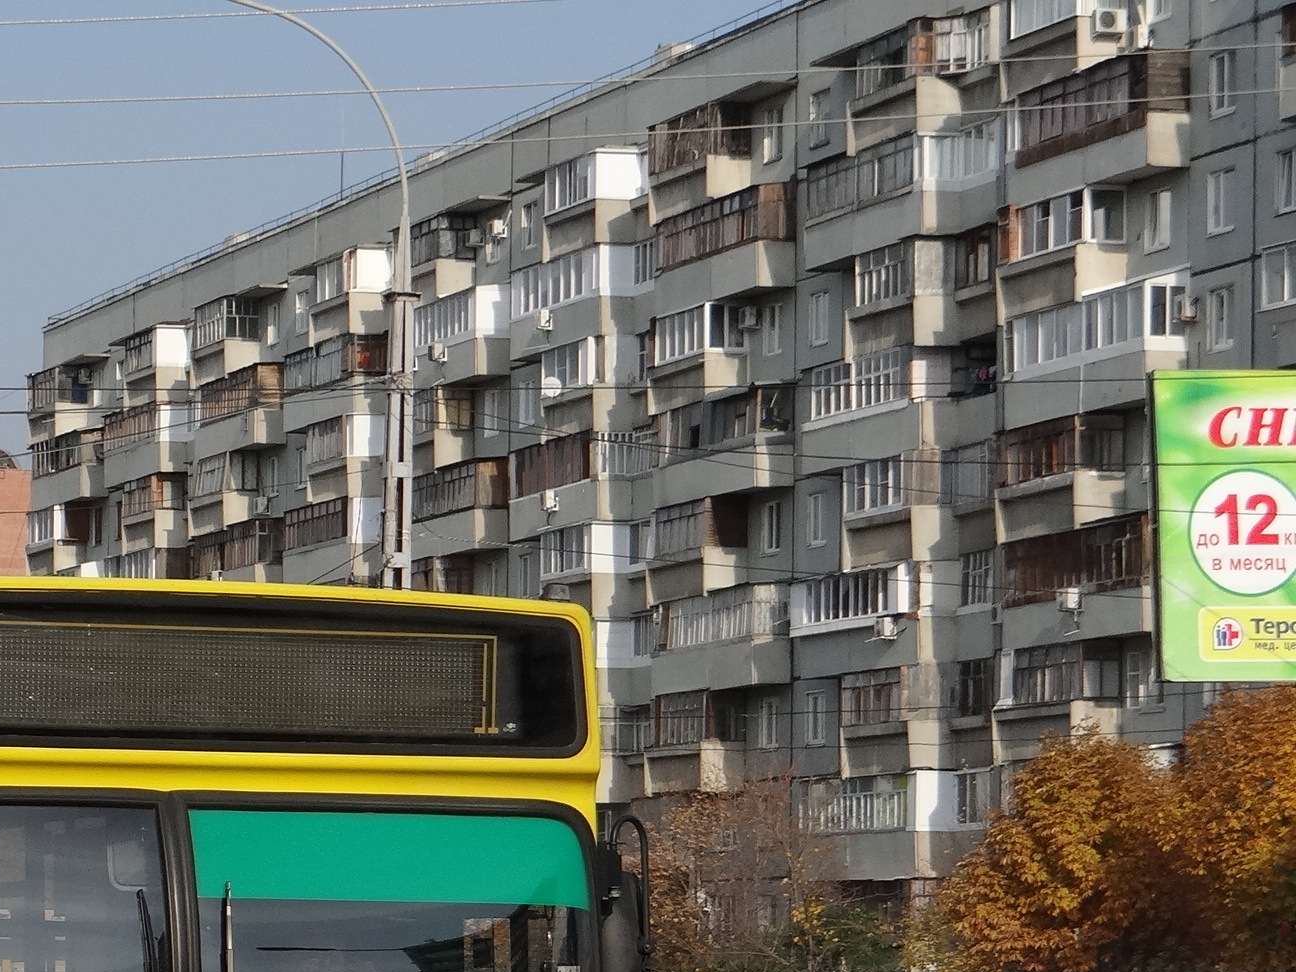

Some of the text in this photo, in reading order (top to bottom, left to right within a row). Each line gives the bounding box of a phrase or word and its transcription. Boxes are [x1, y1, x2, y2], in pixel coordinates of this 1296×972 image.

[1208, 406, 1296, 449] СН
[1197, 534, 1220, 548] до
[1214, 494, 1280, 545] 12
[1212, 557, 1287, 573] в месяц
